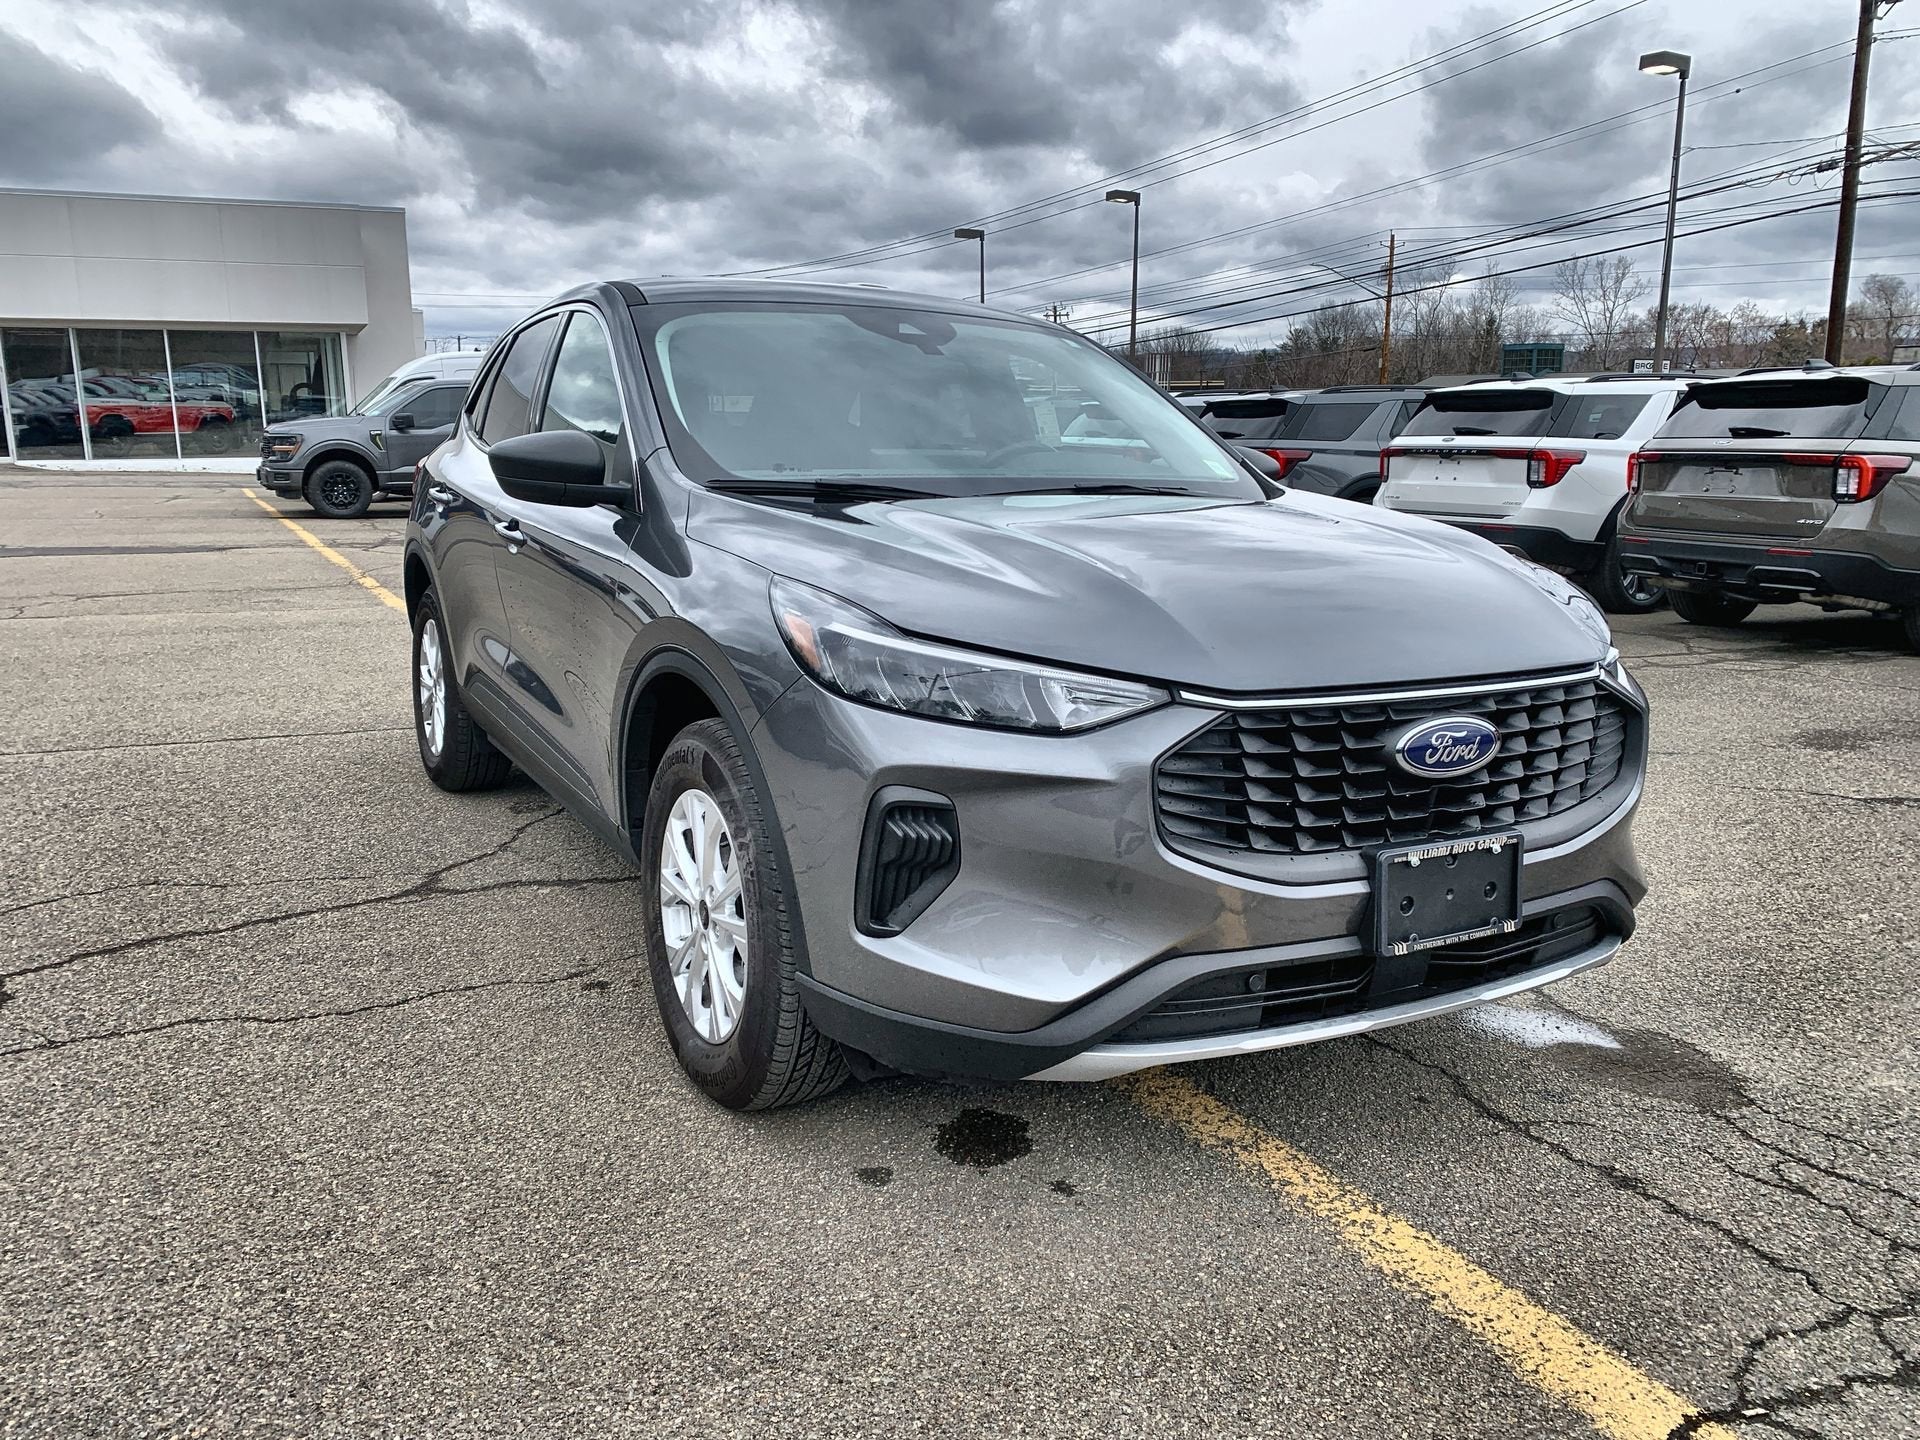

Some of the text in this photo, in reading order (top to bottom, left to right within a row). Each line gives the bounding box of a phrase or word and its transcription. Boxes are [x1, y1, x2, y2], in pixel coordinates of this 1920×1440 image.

[1425, 730, 1481, 765] Ford
[1452, 841, 1476, 855] AUTO
[1413, 928, 1498, 951] PARTNERING WITH THE COMMUNITY
